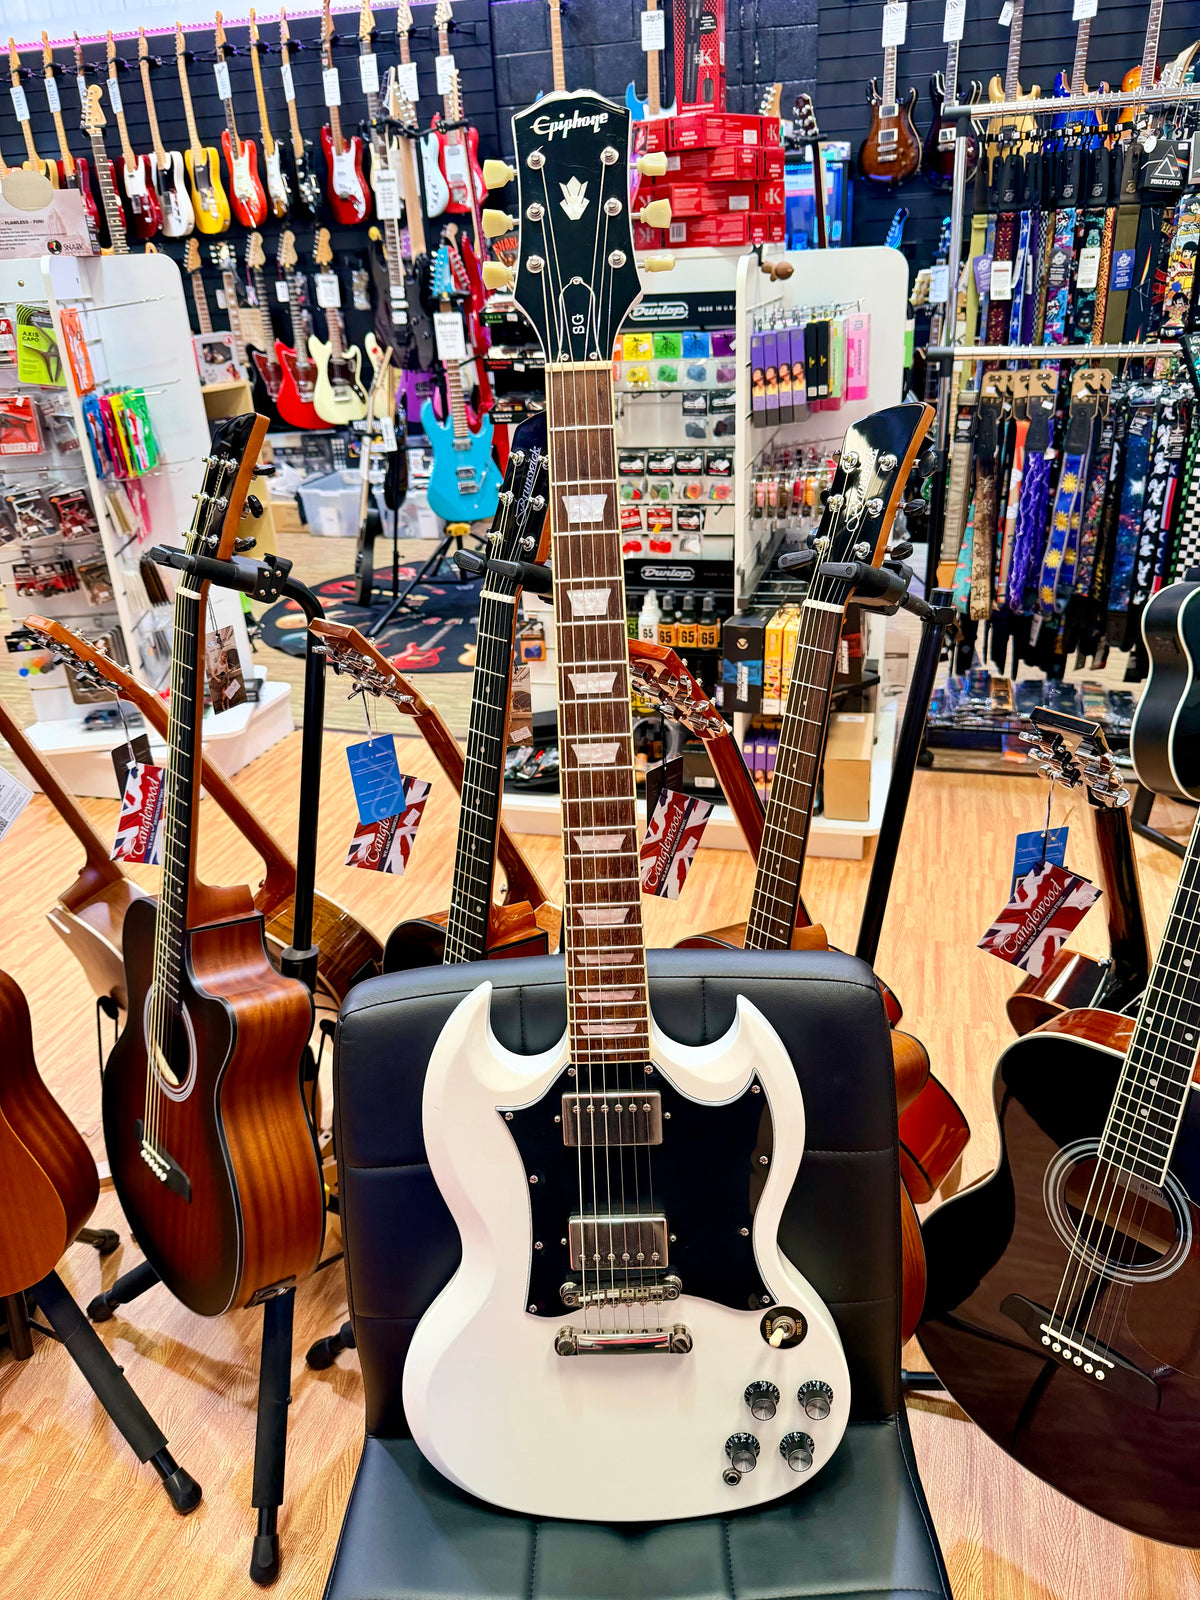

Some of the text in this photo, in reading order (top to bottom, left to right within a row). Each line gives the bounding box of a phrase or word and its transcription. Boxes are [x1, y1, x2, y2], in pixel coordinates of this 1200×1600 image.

[530, 110, 609, 141] Epiphone
[63, 243, 84, 251] SNARK
[632, 304, 687, 318] Dunlop
[572, 313, 585, 335] SG
[515, 446, 542, 527] Brunswick
[644, 567, 693, 579] Dunlop
[643, 628, 654, 639] 65
[660, 630, 672, 644] 65
[681, 630, 694, 643] 65
[701, 631, 715, 645] 65
[130, 775, 160, 859] Tanglewood
[364, 818, 391, 865] Tangle
[644, 803, 683, 889] Tanglewood
[999, 878, 1062, 955] Tanglewood
